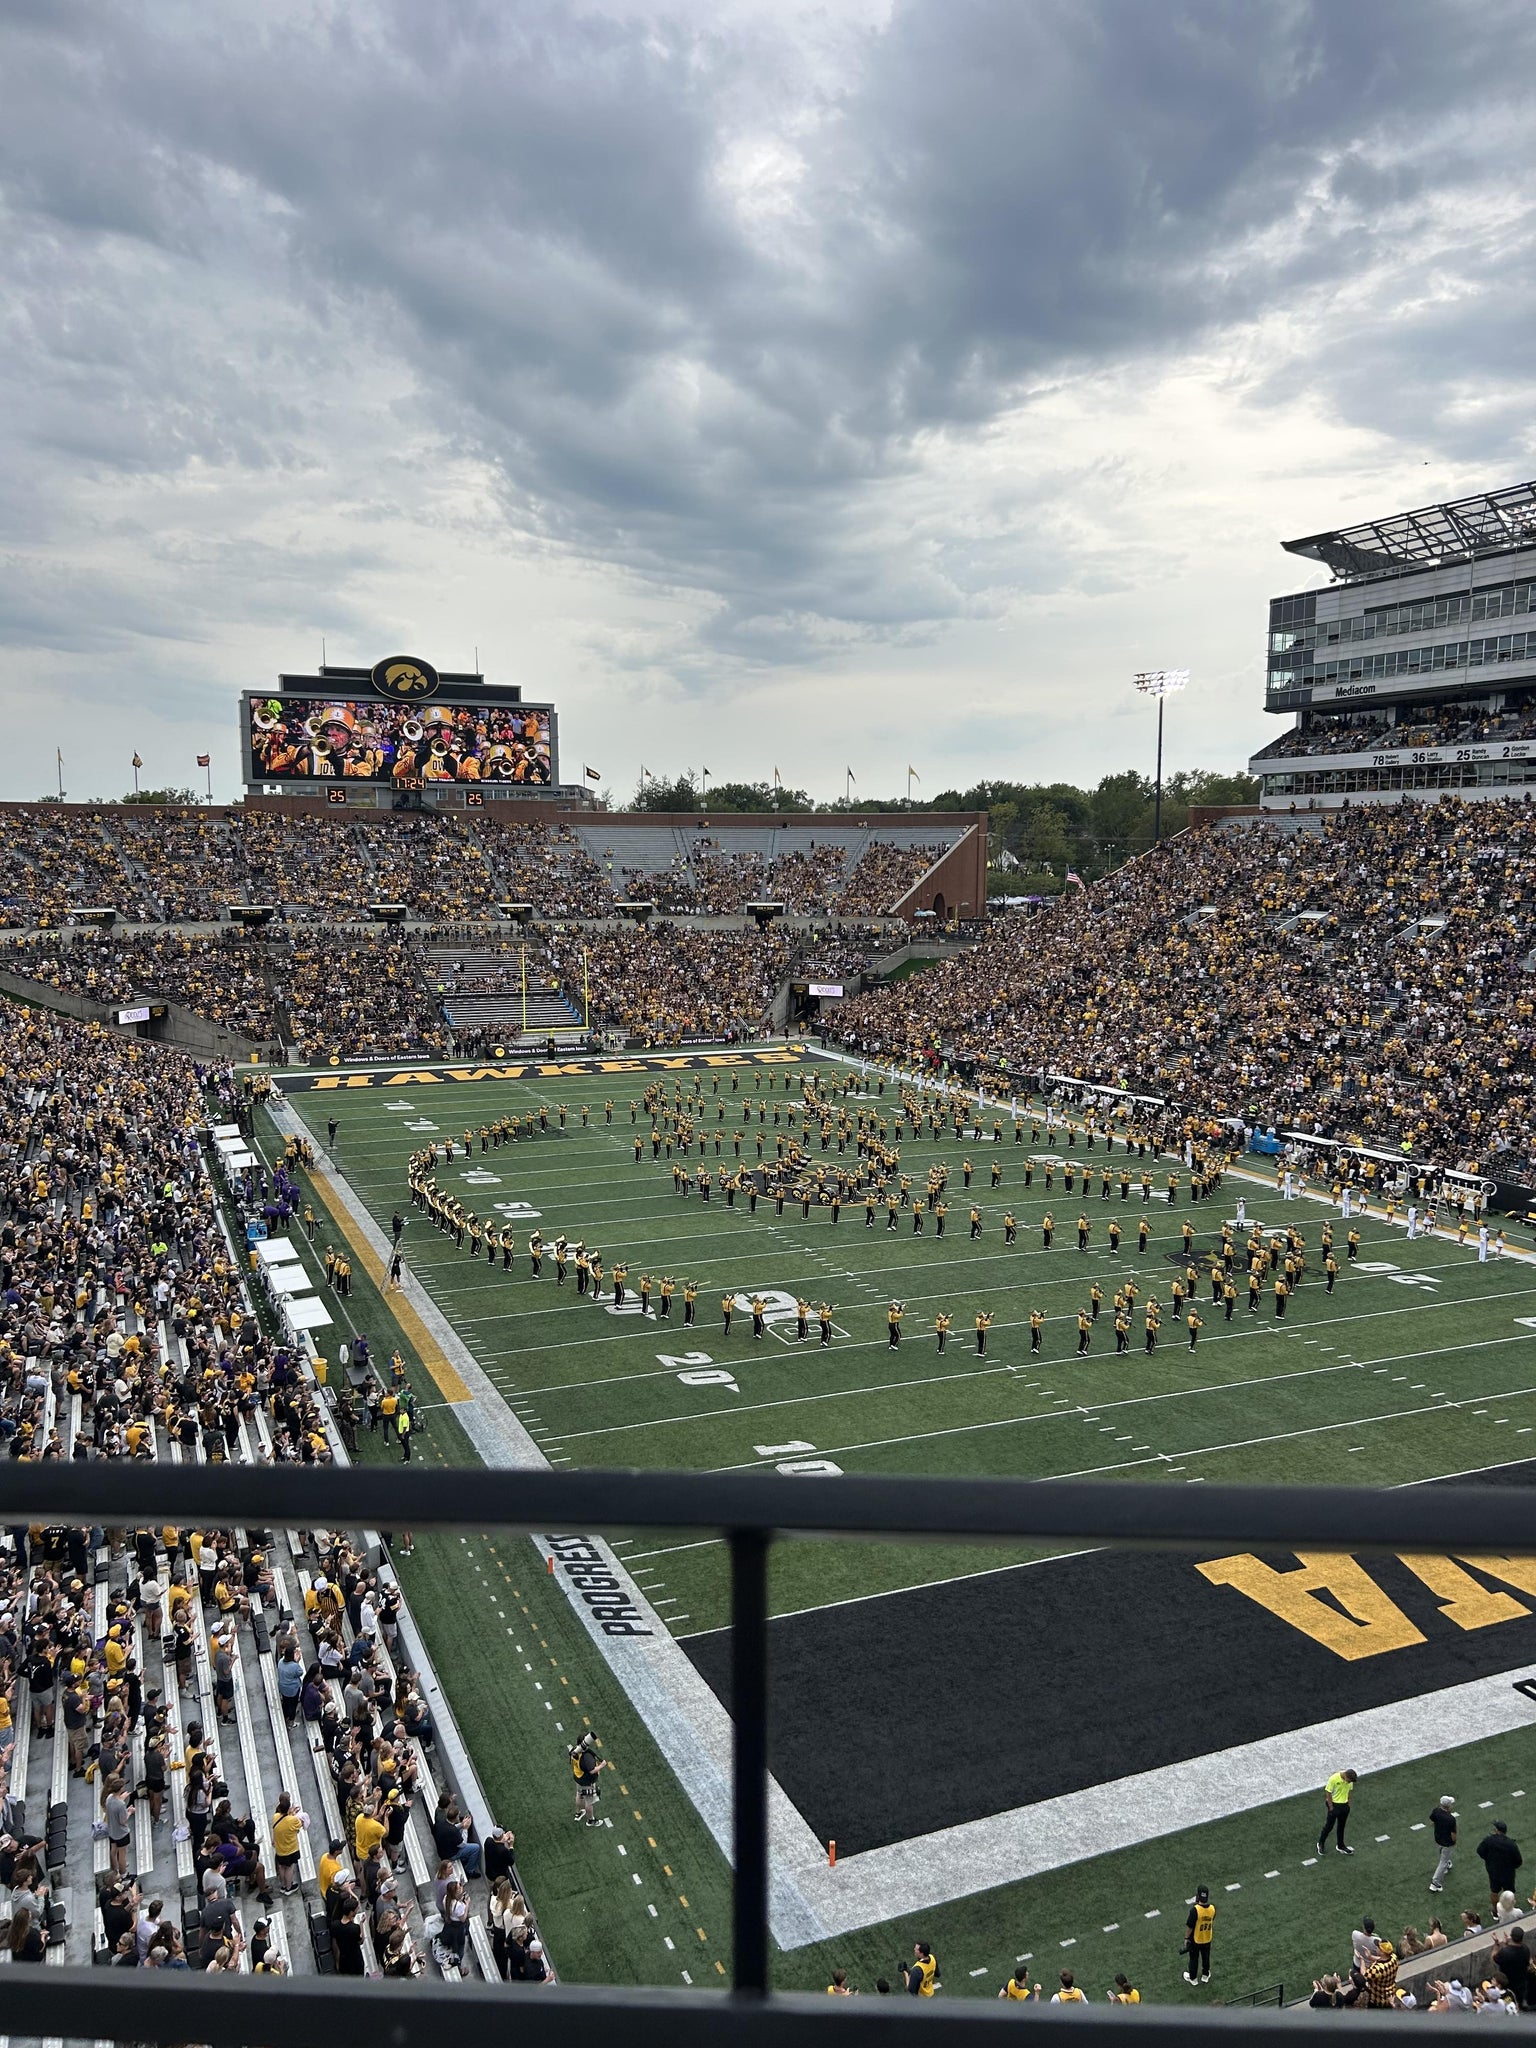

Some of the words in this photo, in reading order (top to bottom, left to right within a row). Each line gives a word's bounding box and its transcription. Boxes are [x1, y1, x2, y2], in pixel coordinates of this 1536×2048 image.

[1335, 685, 1376, 697] Mediacom
[1412, 752, 1426, 763] 36
[1456, 749, 1471, 761] 25
[1503, 747, 1510, 758] 2
[1372, 755, 1385, 766] 78
[396, 778, 425, 790] 17:24
[330, 790, 345, 802] 25
[468, 793, 482, 806] 25
[310, 1052, 802, 1090] HAWKEYES
[492, 1201, 543, 1219] 50
[655, 1351, 736, 1386] 20
[752, 1440, 845, 1478] 10
[51, 1536, 60, 1549] 7
